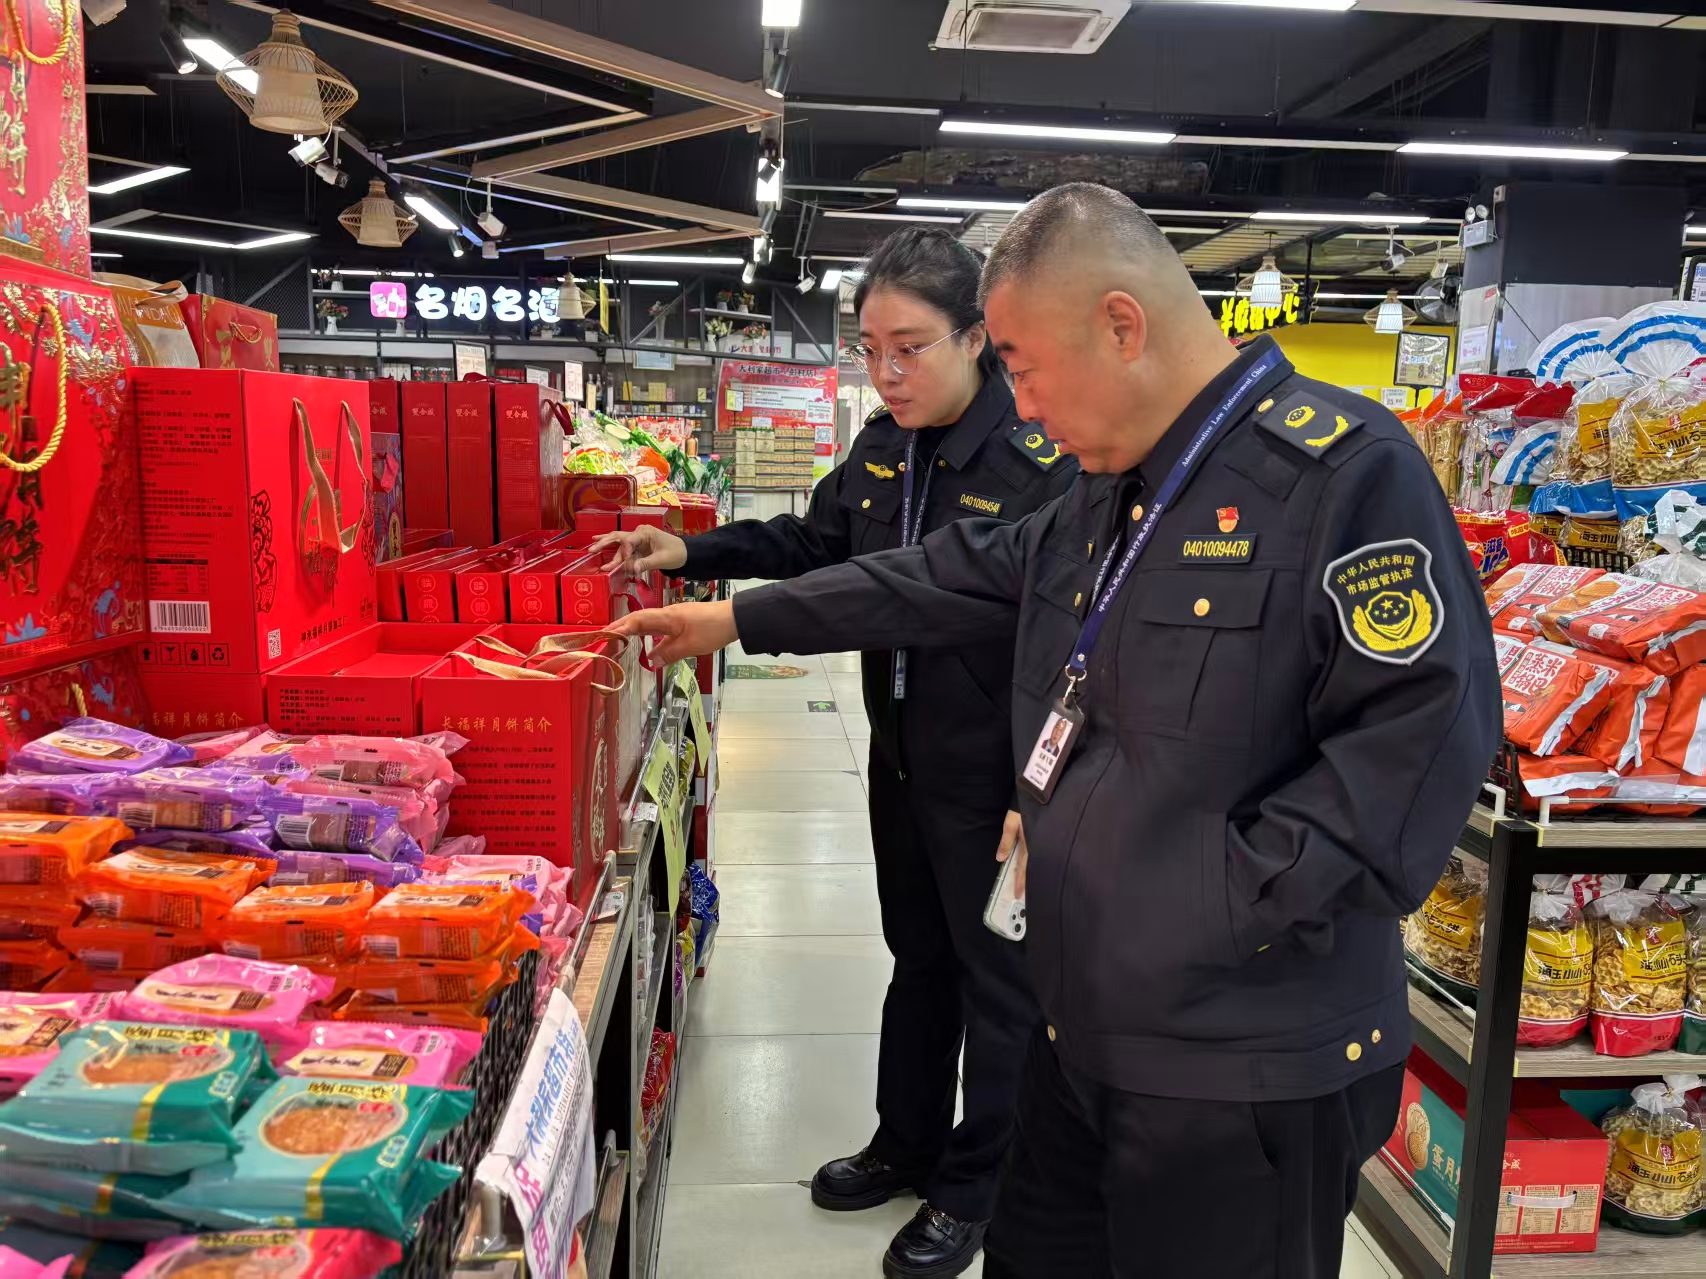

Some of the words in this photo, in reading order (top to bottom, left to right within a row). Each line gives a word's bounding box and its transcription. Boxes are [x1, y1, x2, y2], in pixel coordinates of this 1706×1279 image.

[415, 284, 560, 323] 名烟名酒
[1181, 425, 1214, 467] Administrative
[1213, 412, 1225, 425] Law
[1222, 378, 1253, 412] Enforcement
[1252, 364, 1267, 378] China
[1183, 540, 1249, 557] 04010094478
[1336, 554, 1415, 584] 中华人民共和国
[1346, 569, 1413, 595] 市场监管执法
